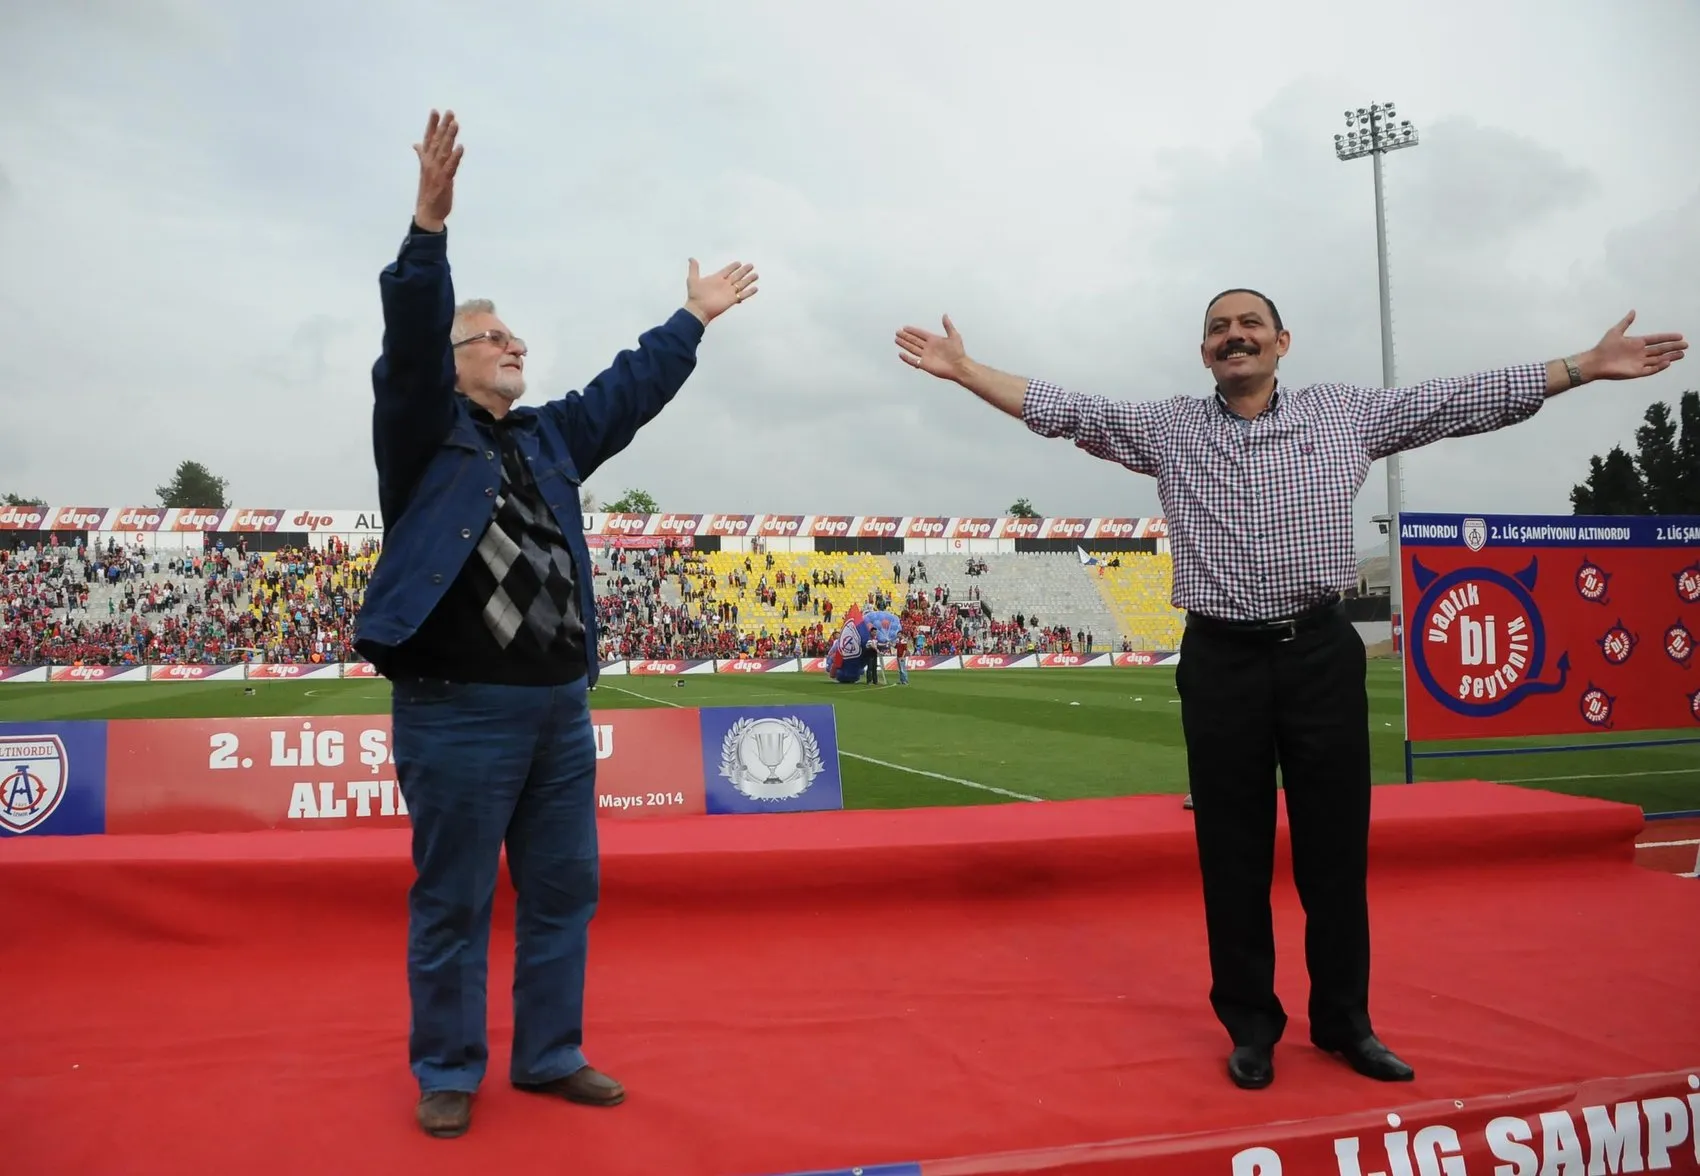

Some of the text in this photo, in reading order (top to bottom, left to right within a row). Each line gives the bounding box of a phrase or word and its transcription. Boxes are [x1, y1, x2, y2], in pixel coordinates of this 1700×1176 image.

[0, 508, 41, 528] dyo
[60, 508, 100, 530] dyo
[120, 509, 160, 529] dyo
[179, 510, 219, 530] dyo
[238, 511, 277, 530] dyo
[293, 511, 333, 531] dyo
[608, 515, 644, 533] dyo
[661, 516, 696, 533] dyo
[713, 516, 748, 534] dyo
[764, 516, 798, 534] dyo
[815, 517, 847, 535] dyo
[864, 517, 896, 536] dyo
[911, 518, 943, 537] dyo
[959, 519, 990, 536] dyo
[1006, 519, 1038, 537] dyo
[1053, 519, 1085, 537] dyo
[1101, 519, 1132, 536] dyo
[1401, 525, 1458, 538] ALTINORDU
[1491, 524, 1630, 543] 2. LİG ŞAMPİYONU ALTINORDU
[1656, 528, 1666, 540] 2.
[1667, 525, 1682, 540] LİG
[1428, 583, 1480, 644] yaptık
[1460, 615, 1496, 666] bi
[647, 660, 676, 674] dyo
[733, 660, 762, 673] dyo
[977, 655, 1003, 667] dyo
[1053, 654, 1079, 666] dyo
[1127, 653, 1151, 665] dyo
[70, 665, 104, 679] dyo
[170, 665, 203, 679] dyo
[210, 722, 396, 773] 2. LİG Ş
[598, 792, 684, 810] Mayıs 2014
